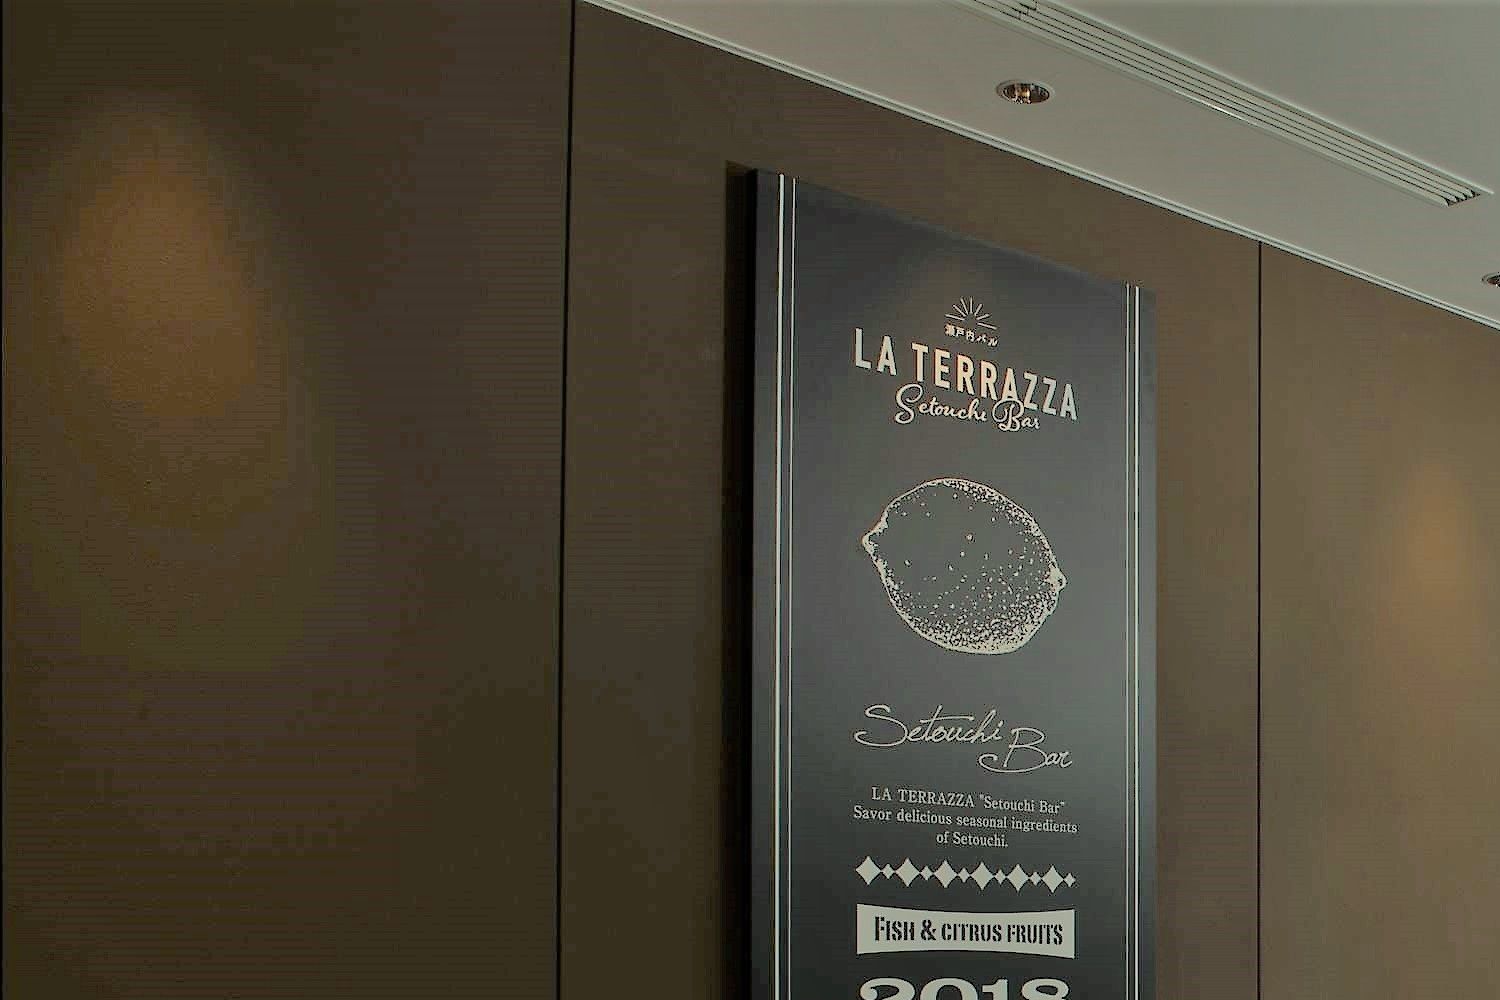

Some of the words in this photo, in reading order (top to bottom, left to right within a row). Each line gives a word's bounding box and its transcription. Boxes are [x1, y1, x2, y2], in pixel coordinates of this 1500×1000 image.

[854, 327, 898, 376] LA
[912, 341, 1078, 421] TERRAZZA
[894, 383, 989, 426] Setouchi
[992, 398, 1041, 432] Bar
[854, 704, 1004, 748] Setouchi
[977, 726, 1073, 773] Bar
[871, 787, 893, 802] LA
[898, 789, 975, 808] TERRAZZA
[854, 804, 893, 822] Savor
[897, 808, 953, 825] delicious
[956, 813, 1008, 830] seasonal
[1011, 816, 1078, 836] ingredients
[936, 830, 951, 845] of
[953, 831, 1009, 849] Setouchi.
[874, 915, 915, 942] FISH
[920, 918, 937, 941] &
[941, 923, 1002, 943] CITRUS
[1007, 923, 1064, 946] FRUITS
